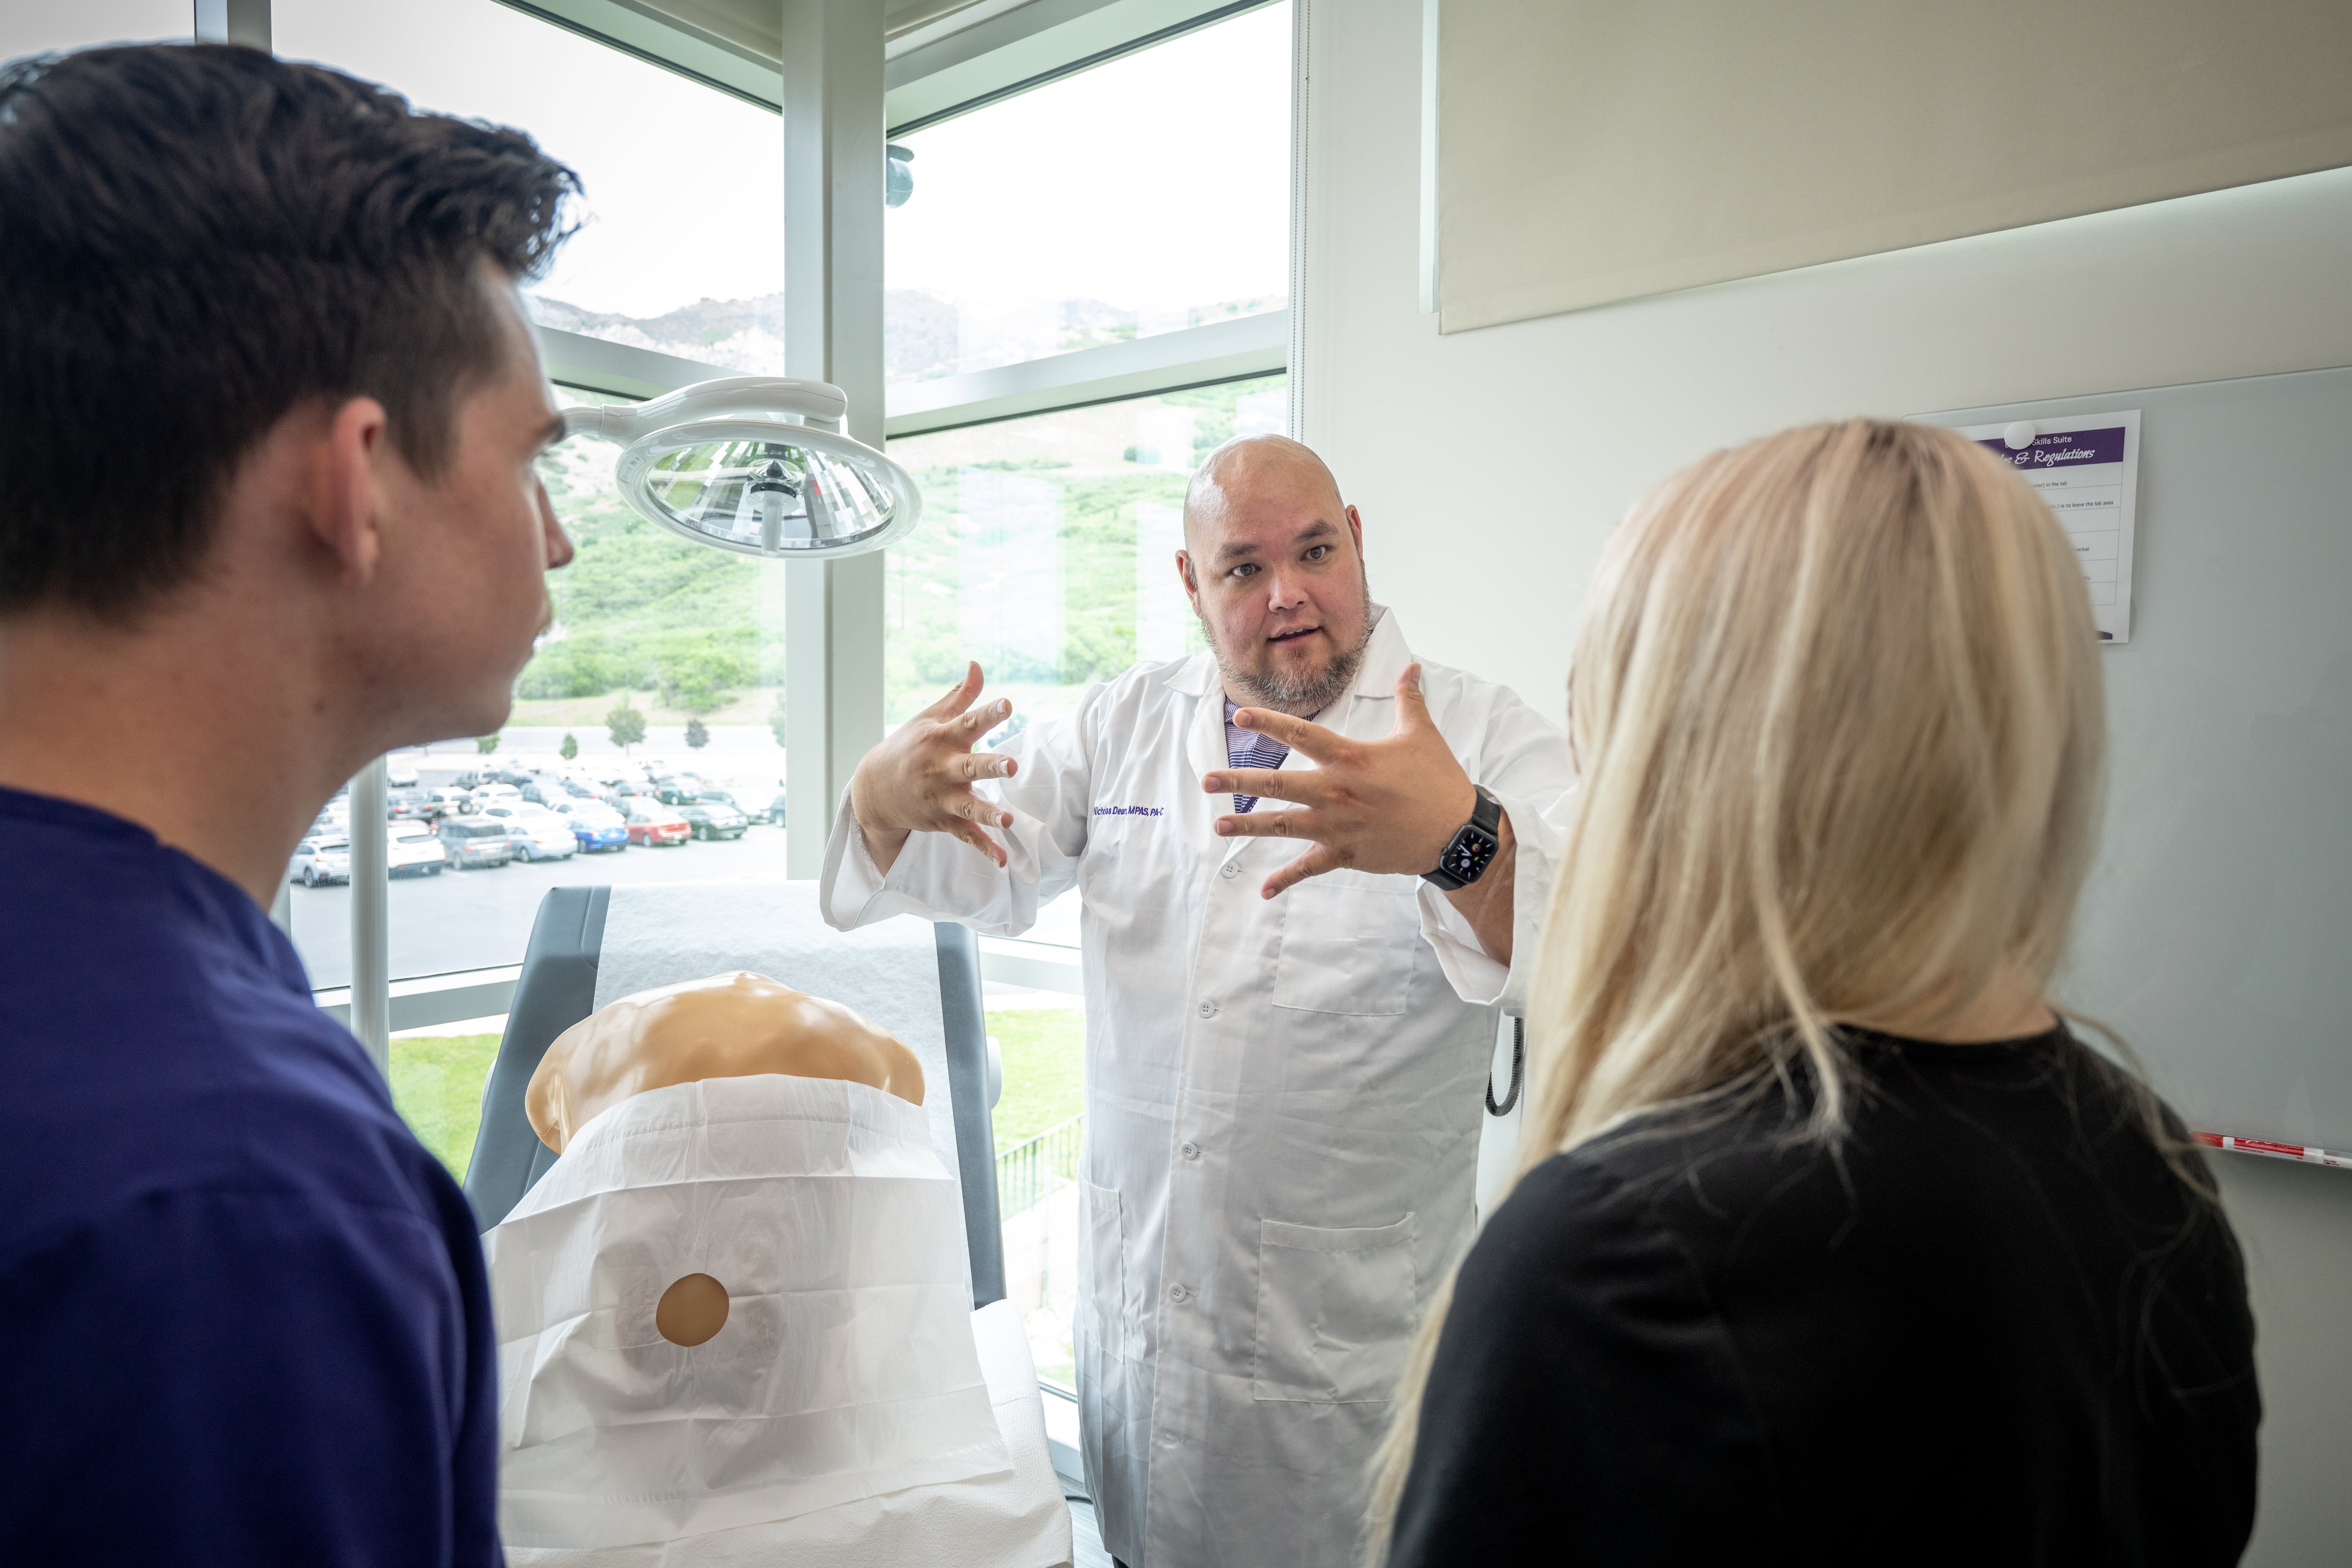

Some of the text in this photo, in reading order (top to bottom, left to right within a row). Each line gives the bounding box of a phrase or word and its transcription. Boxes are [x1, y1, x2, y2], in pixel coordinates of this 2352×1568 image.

[2014, 452, 2030, 464] &
[2034, 448, 2095, 467] Regulations
[1128, 805, 1149, 816] MPAS,
[1150, 807, 1164, 816] PA-C
